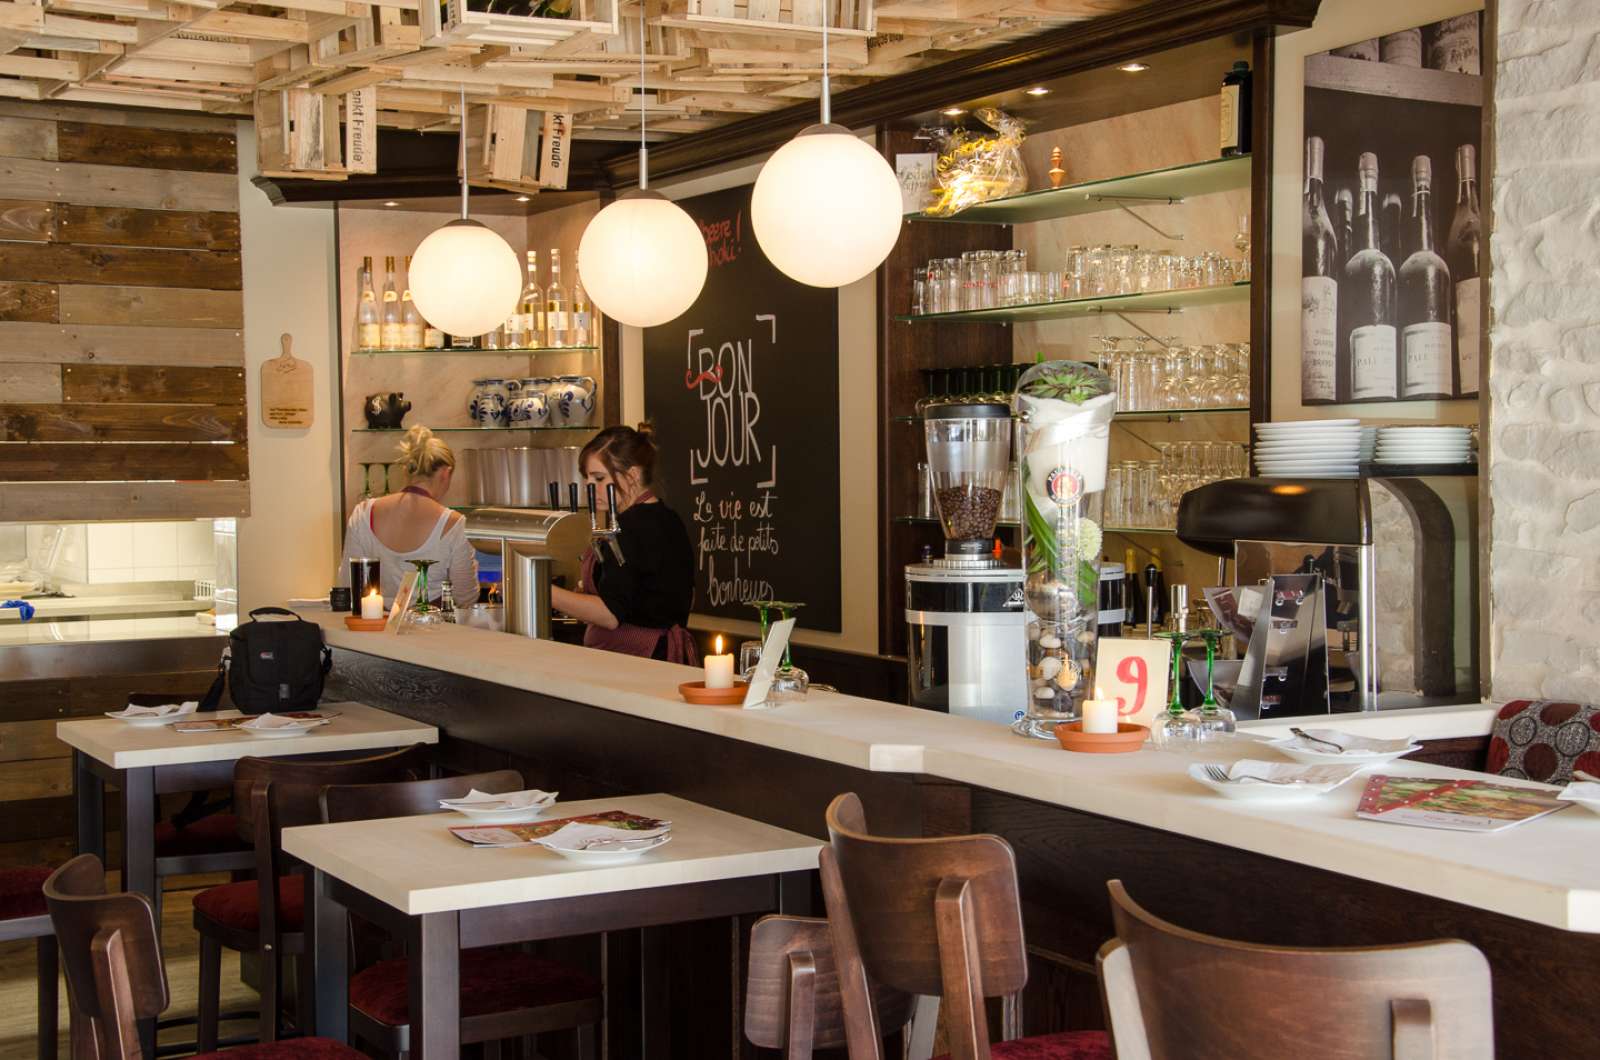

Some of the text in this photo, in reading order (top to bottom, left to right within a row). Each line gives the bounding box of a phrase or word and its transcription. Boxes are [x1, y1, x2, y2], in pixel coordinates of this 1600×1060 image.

[351, 118, 365, 163] Freude
[550, 127, 565, 169] Freude
[698, 339, 753, 401] BON
[696, 391, 762, 468] JOUR
[693, 490, 779, 523] La vie est
[697, 520, 779, 571] faite de petits
[1115, 655, 1148, 718] 9
